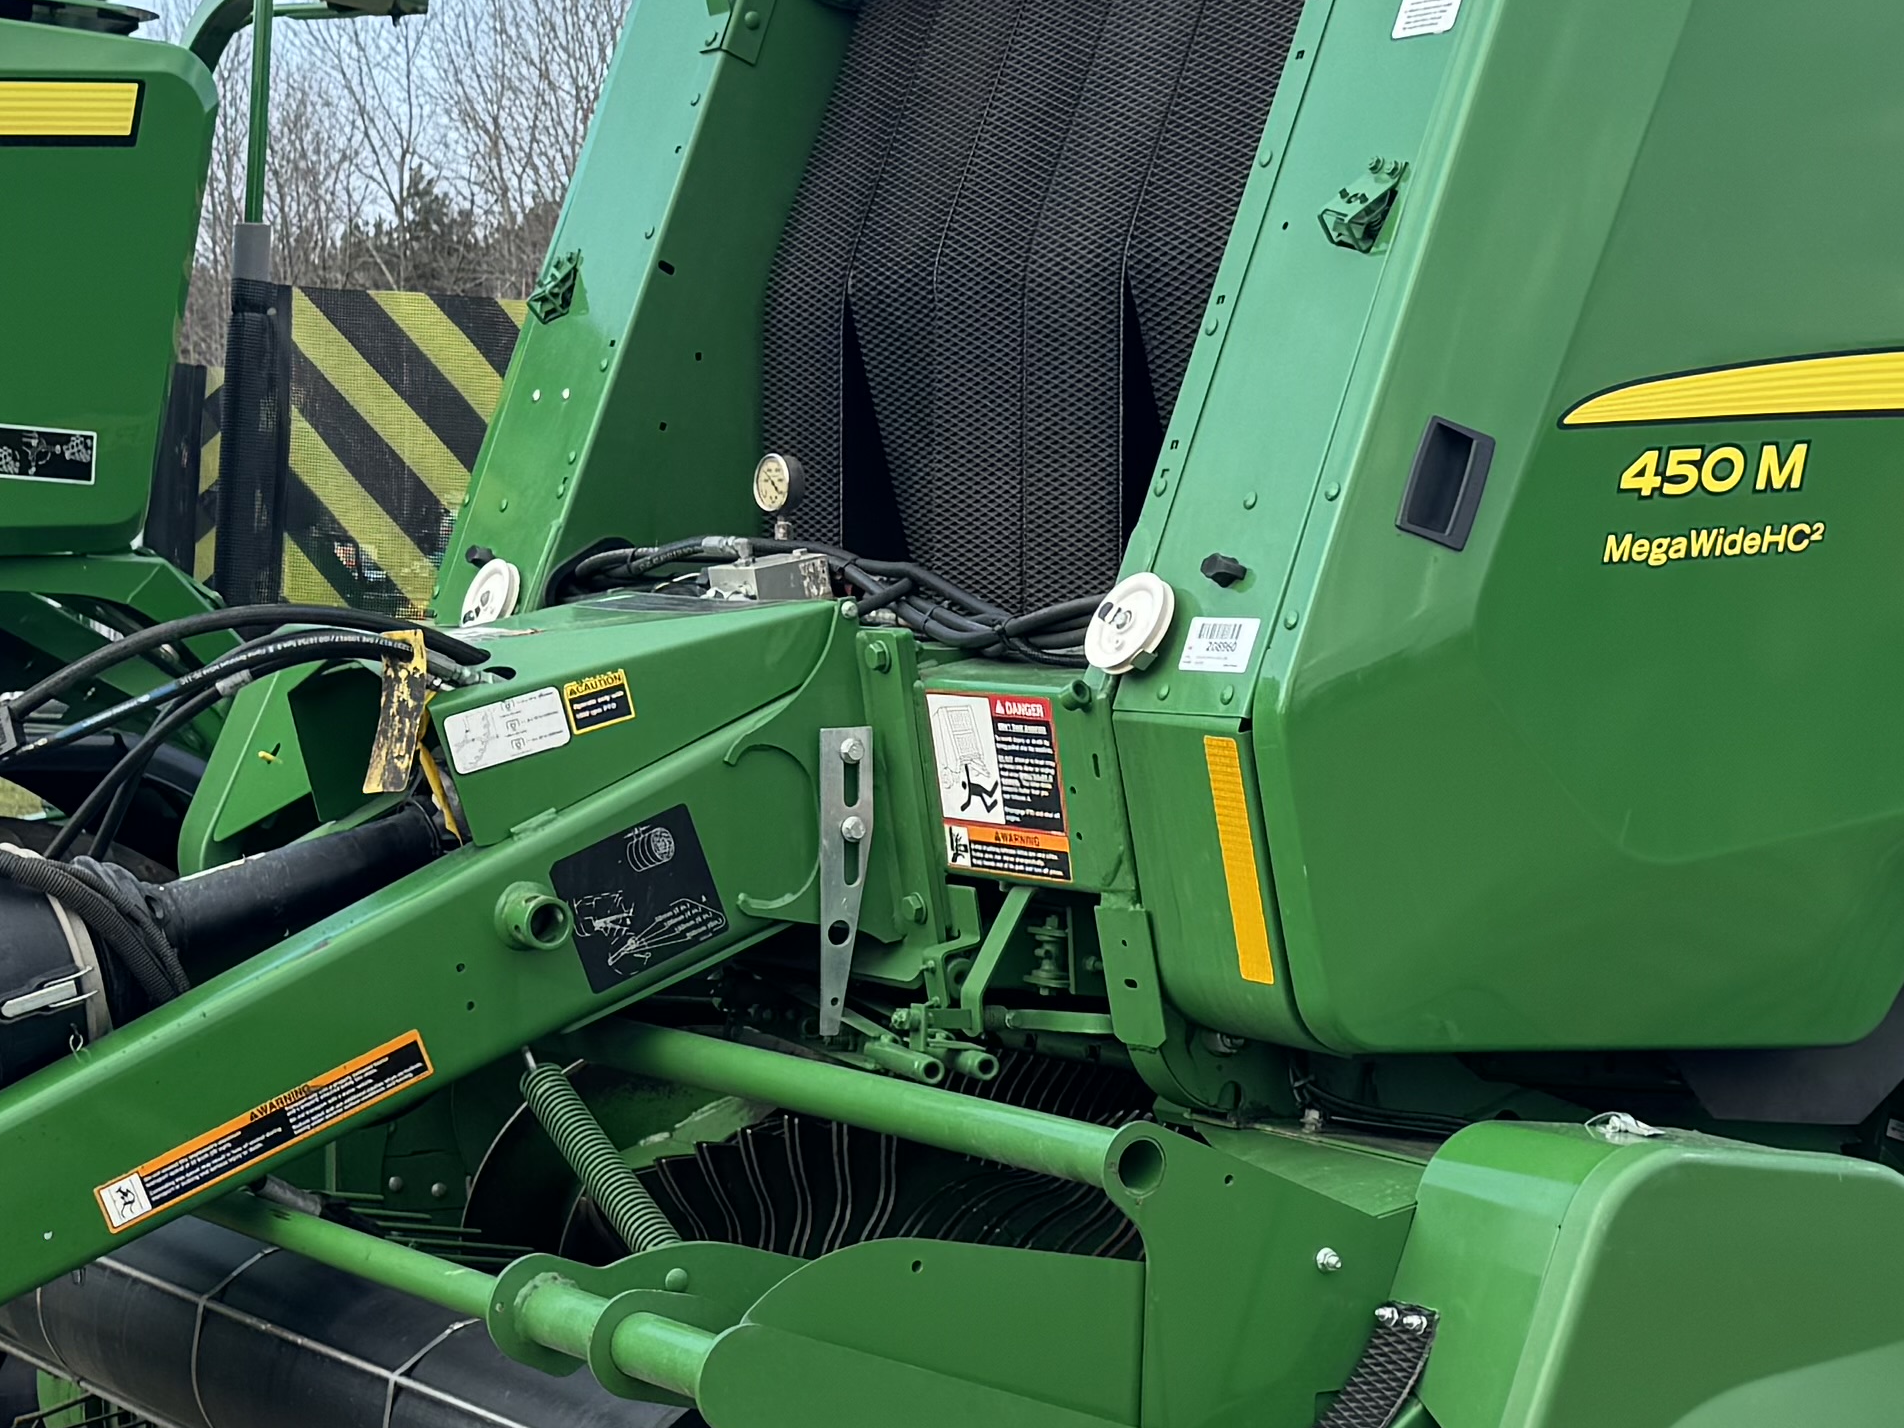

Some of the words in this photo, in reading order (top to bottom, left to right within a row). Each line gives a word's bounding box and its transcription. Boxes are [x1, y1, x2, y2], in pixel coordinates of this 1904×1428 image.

[1618, 443, 1745, 498] 450
[1753, 440, 1811, 493] M
[576, 673, 622, 694] CAUTION
[1005, 701, 1044, 717] DANGER
[1002, 832, 1041, 847] WARNING
[257, 1083, 310, 1117] WARNING
